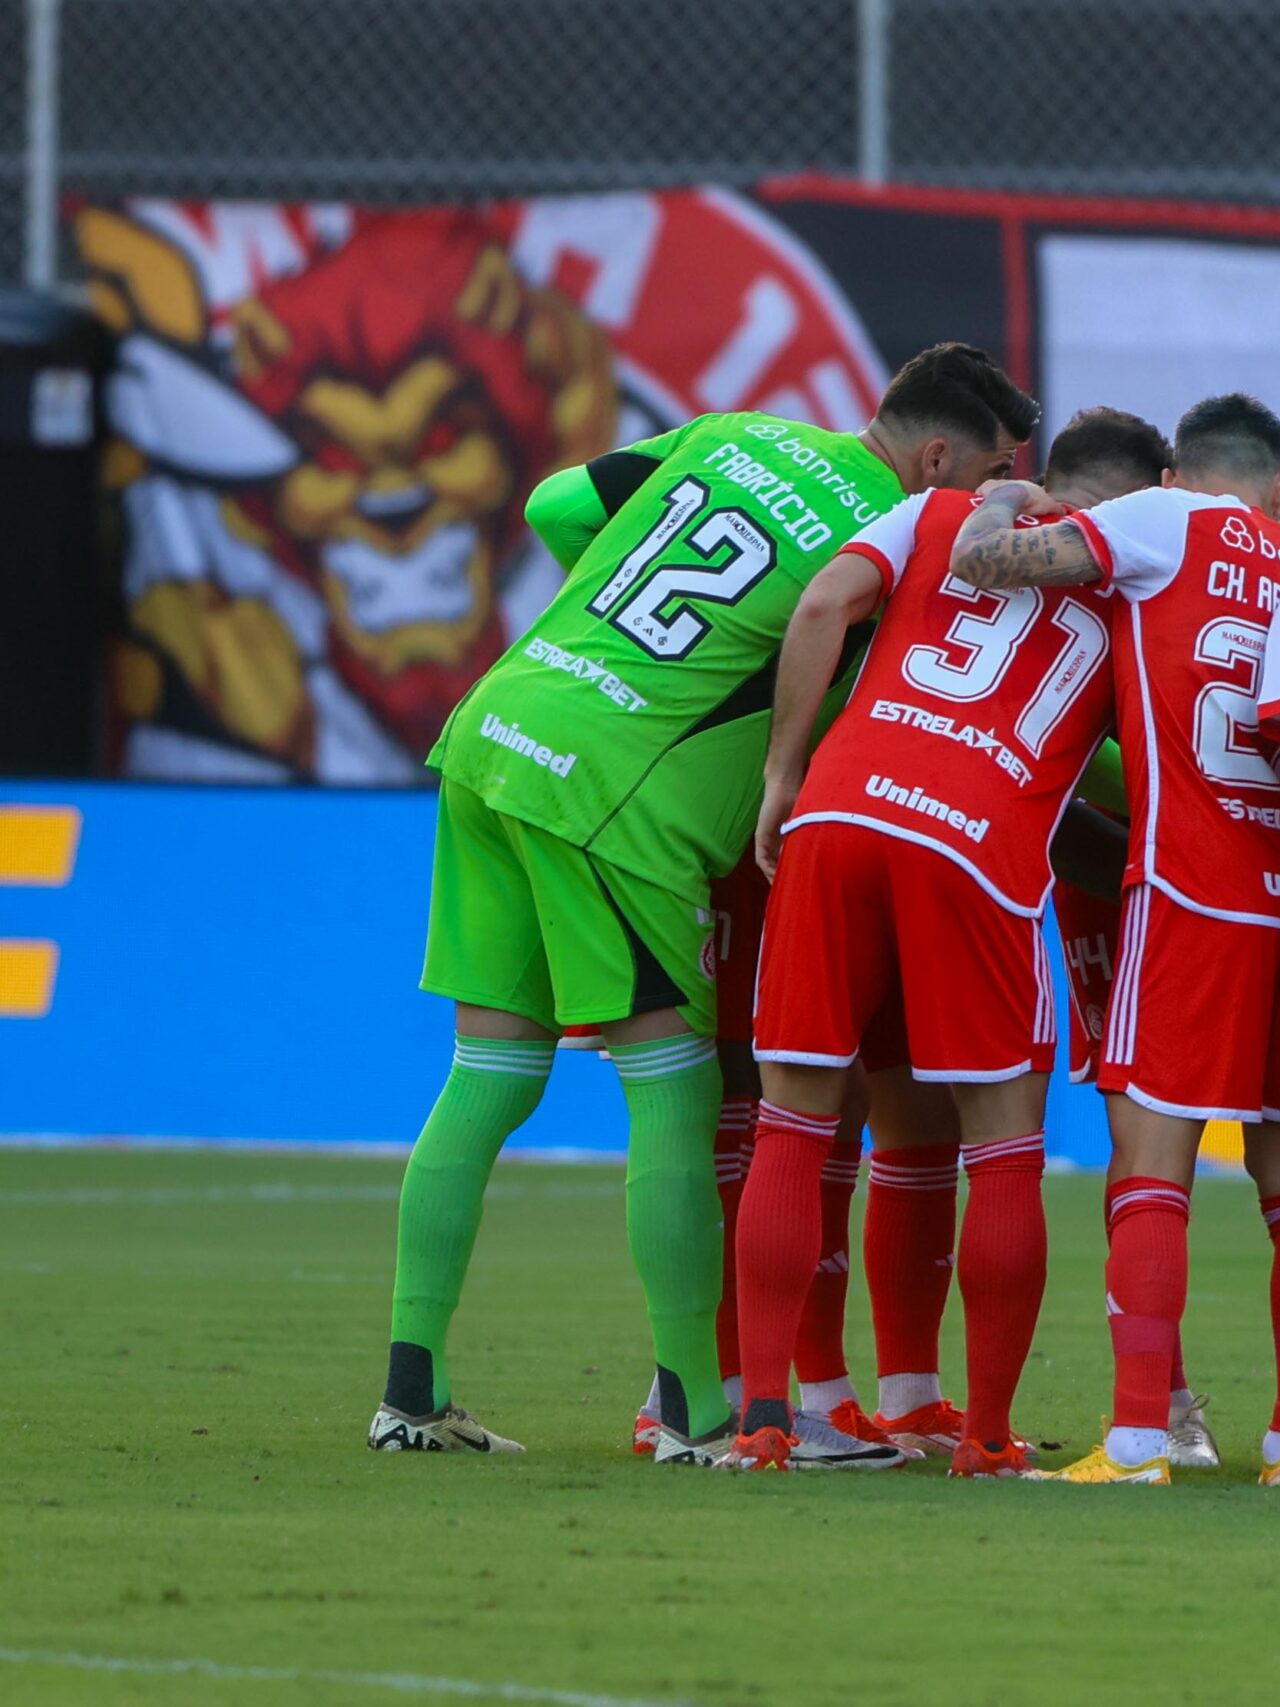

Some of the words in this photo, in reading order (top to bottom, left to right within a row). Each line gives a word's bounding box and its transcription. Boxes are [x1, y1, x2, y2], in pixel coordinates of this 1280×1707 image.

[704, 443, 832, 552] FABRÍCIO
[586, 473, 778, 661] 12
[1207, 560, 1248, 604] CH.
[901, 572, 1109, 760] 31
[480, 713, 578, 779] Unimed
[865, 775, 990, 844] Unimed
[1065, 932, 1113, 986] 44
